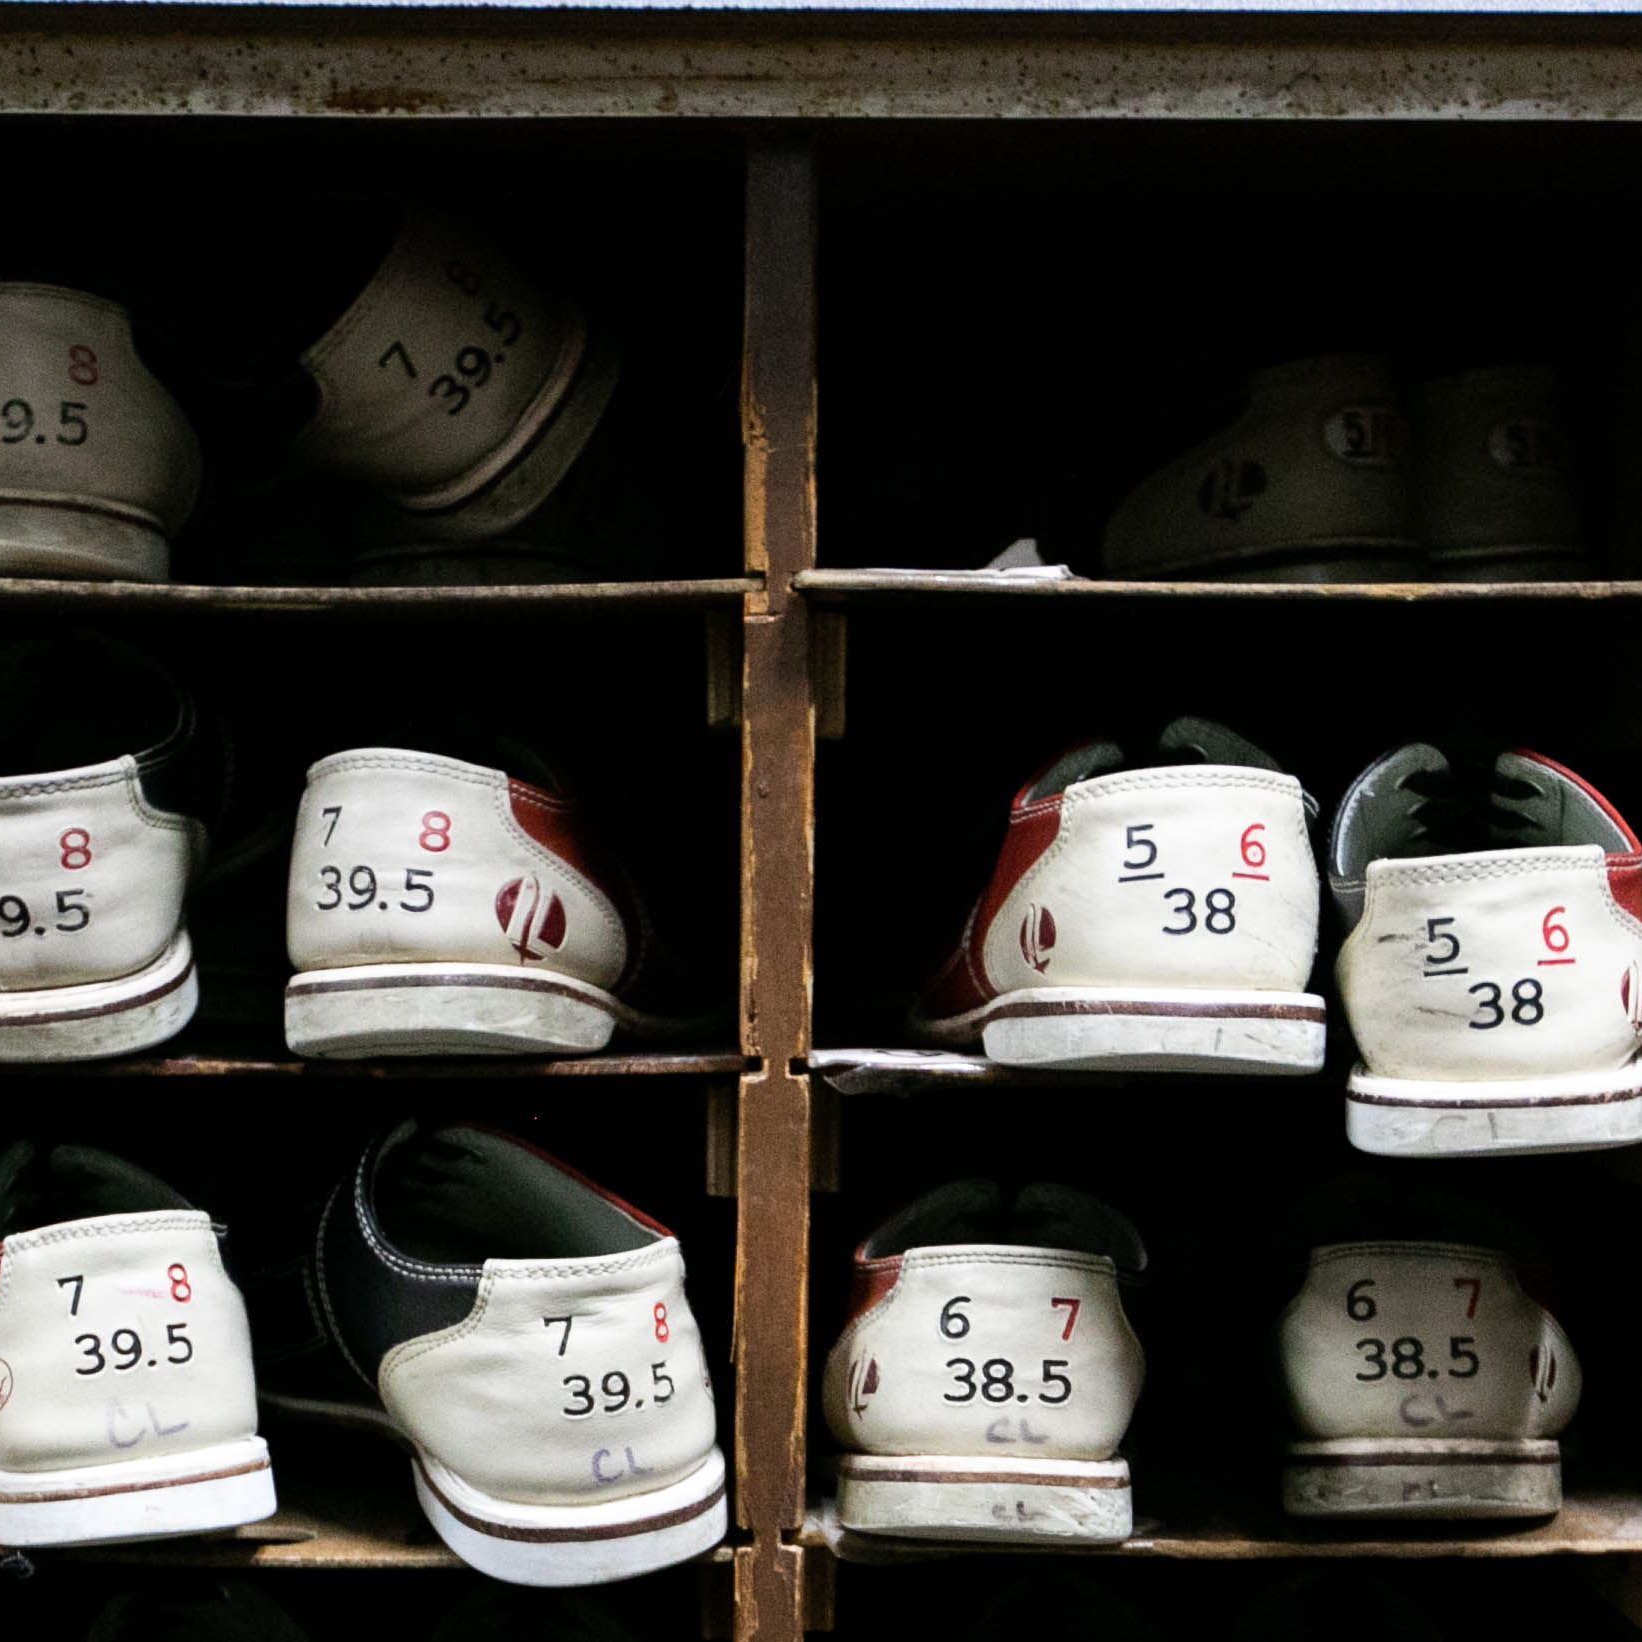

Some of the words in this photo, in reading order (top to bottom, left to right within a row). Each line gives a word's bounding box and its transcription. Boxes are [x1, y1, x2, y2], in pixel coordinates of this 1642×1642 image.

[379, 341, 420, 384] 7
[446, 260, 481, 296] 8
[66, 344, 100, 387] 8
[427, 302, 524, 417] 39.5
[59, 828, 92, 869] 8
[320, 806, 344, 847] 7
[418, 811, 450, 852] 8
[1123, 825, 1158, 870] 5
[1239, 824, 1267, 868] 6
[316, 864, 434, 913] 39.5
[1163, 887, 1236, 934] 38
[1426, 919, 1460, 964] 5
[1543, 907, 1570, 952] 6
[1468, 979, 1544, 1029] 38
[57, 1275, 85, 1315] 7
[167, 1263, 191, 1302] 8
[1347, 1280, 1375, 1321] 6
[1455, 1279, 1480, 1317] 7
[544, 1315, 573, 1355] 7
[653, 1303, 668, 1341] 8
[941, 1296, 971, 1339] 6
[1051, 1299, 1080, 1339] 7
[74, 1323, 194, 1375] 39.5
[1356, 1337, 1478, 1381] 38.5
[563, 1361, 675, 1416] 39.5
[944, 1359, 1072, 1404] 38.5
